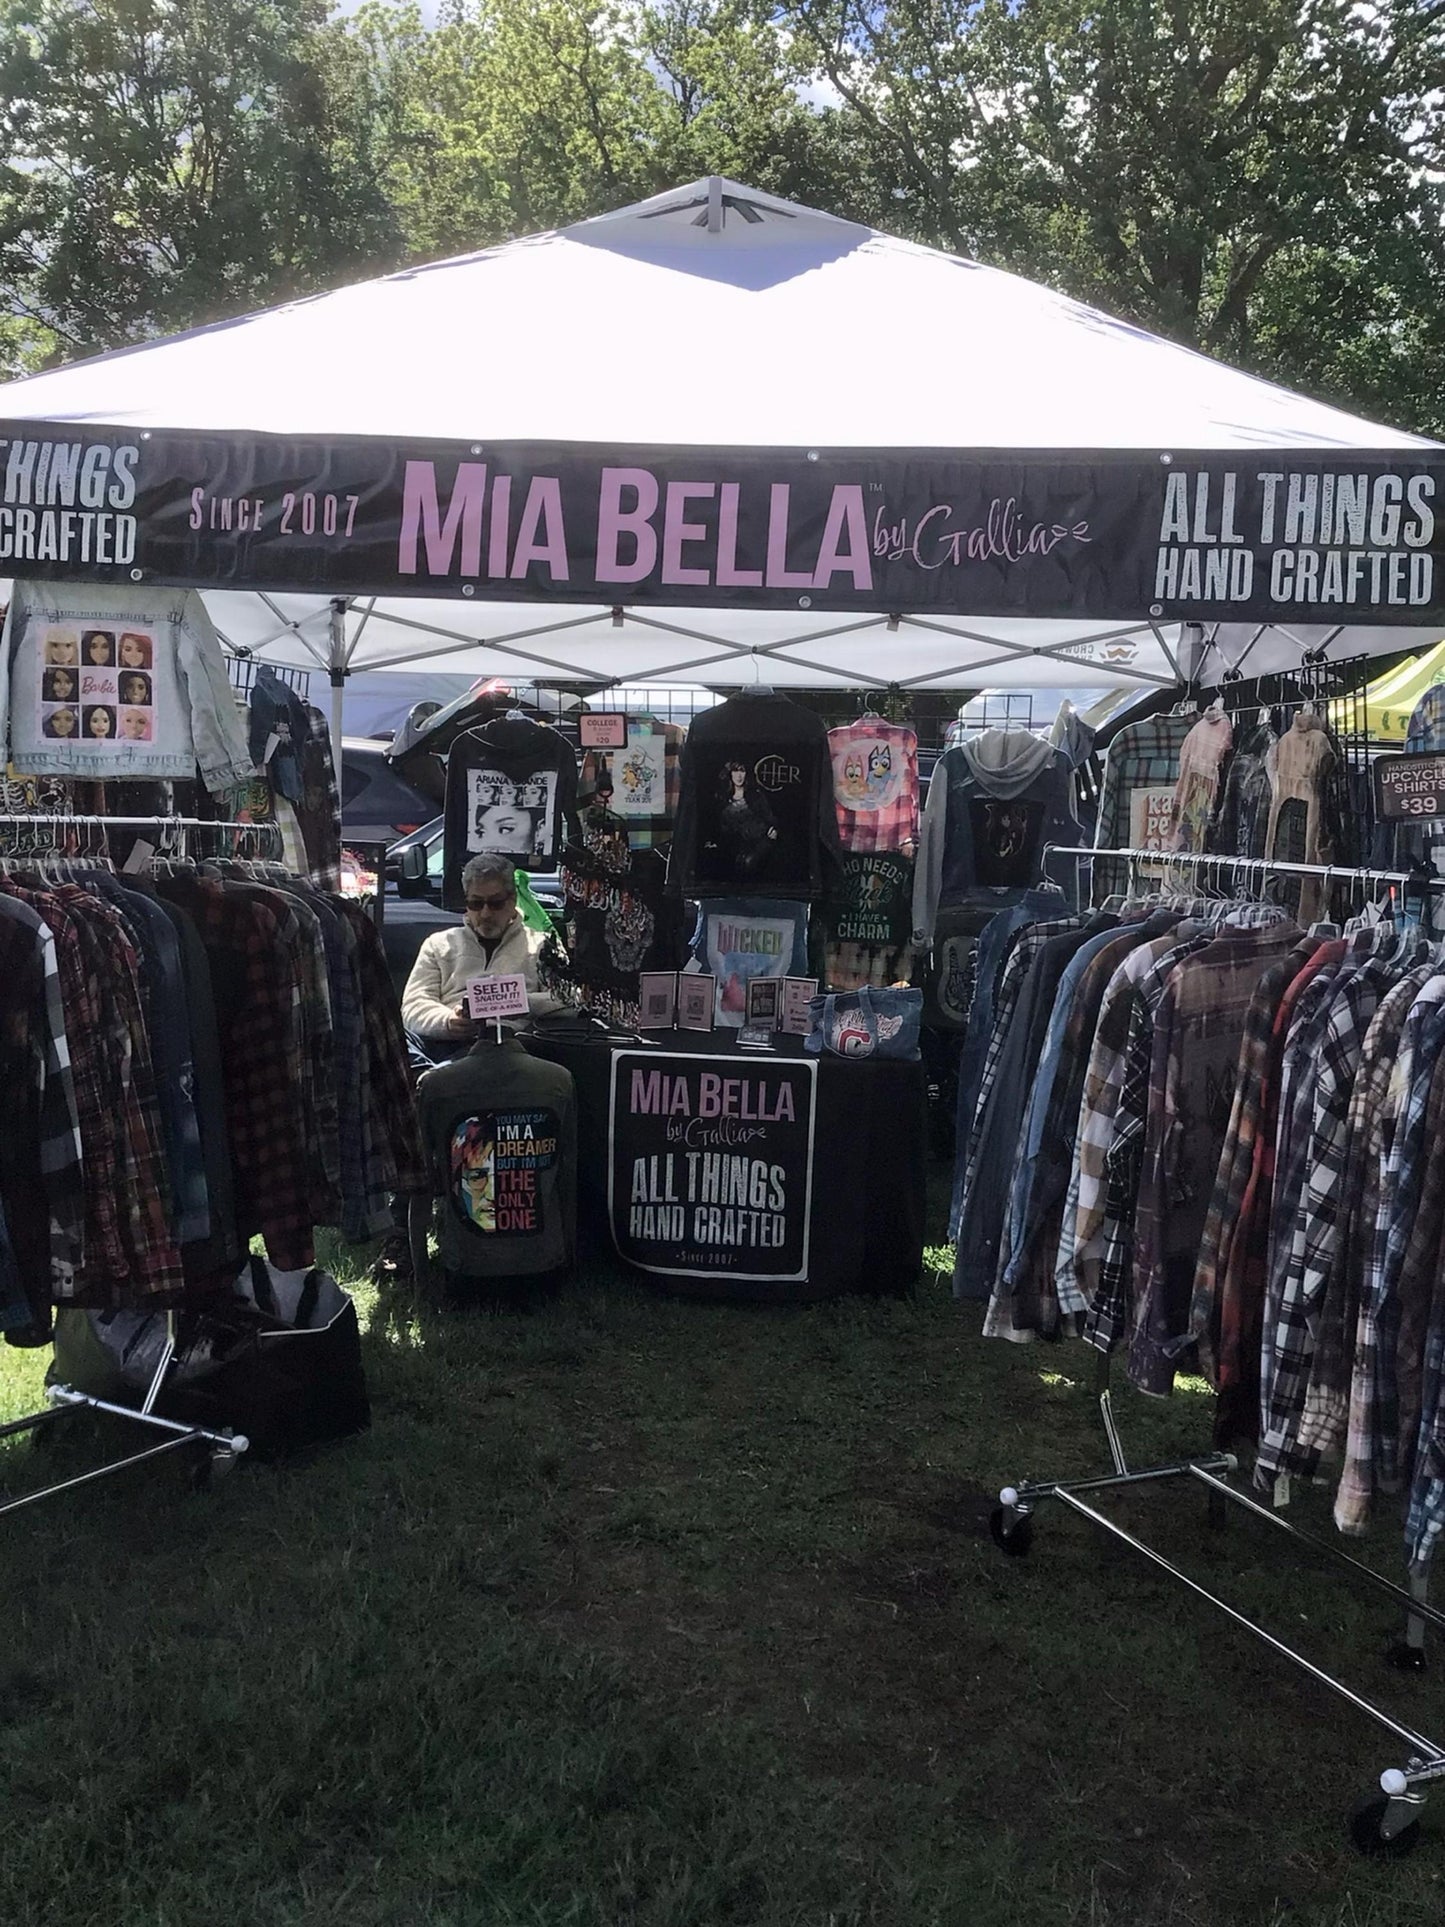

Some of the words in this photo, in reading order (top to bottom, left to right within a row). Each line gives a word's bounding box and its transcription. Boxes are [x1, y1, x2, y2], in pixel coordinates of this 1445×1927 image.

[280, 492, 359, 537] 2007
[1160, 472, 1244, 543] ALL
[1257, 473, 1435, 547] THINGS
[398, 460, 569, 581] MIA
[595, 467, 873, 590] BELLA
[874, 505, 913, 561] by
[912, 497, 1060, 570] Gallia
[1155, 547, 1254, 600] HAND
[1270, 549, 1433, 605] CRAFTED
[81, 676, 117, 695] Barbie
[587, 719, 618, 727] COLLEGE
[476, 775, 509, 785] ARIANA
[754, 754, 801, 792] CHER
[1394, 780, 1445, 794] SHIRTS
[1401, 797, 1437, 815] $39
[840, 858, 860, 876] HO
[863, 857, 904, 884] NEEDS
[856, 913, 880, 923] HAVE
[838, 922, 891, 940] CHARM
[473, 984, 498, 995] SEE
[500, 981, 518, 992] IT?
[475, 993, 507, 1003] SNATCH
[630, 1069, 690, 1117] MIA
[700, 1072, 795, 1122] BELLA
[513, 1115, 531, 1124] MAY
[497, 1125, 519, 1140] I'M
[523, 1124, 534, 1140] A
[667, 1117, 684, 1142] by
[684, 1115, 753, 1148] Gallia
[497, 1138, 556, 1157] DREAMER
[497, 1159, 516, 1169] BUT
[521, 1158, 535, 1168] I'M
[497, 1170, 536, 1191] THE
[631, 1152, 679, 1203] ALL
[685, 1152, 786, 1211] THINGS
[498, 1192, 536, 1208] ONLY
[497, 1209, 536, 1230] ONE
[629, 1205, 685, 1242] HAND
[693, 1206, 786, 1247] CRAFTED
